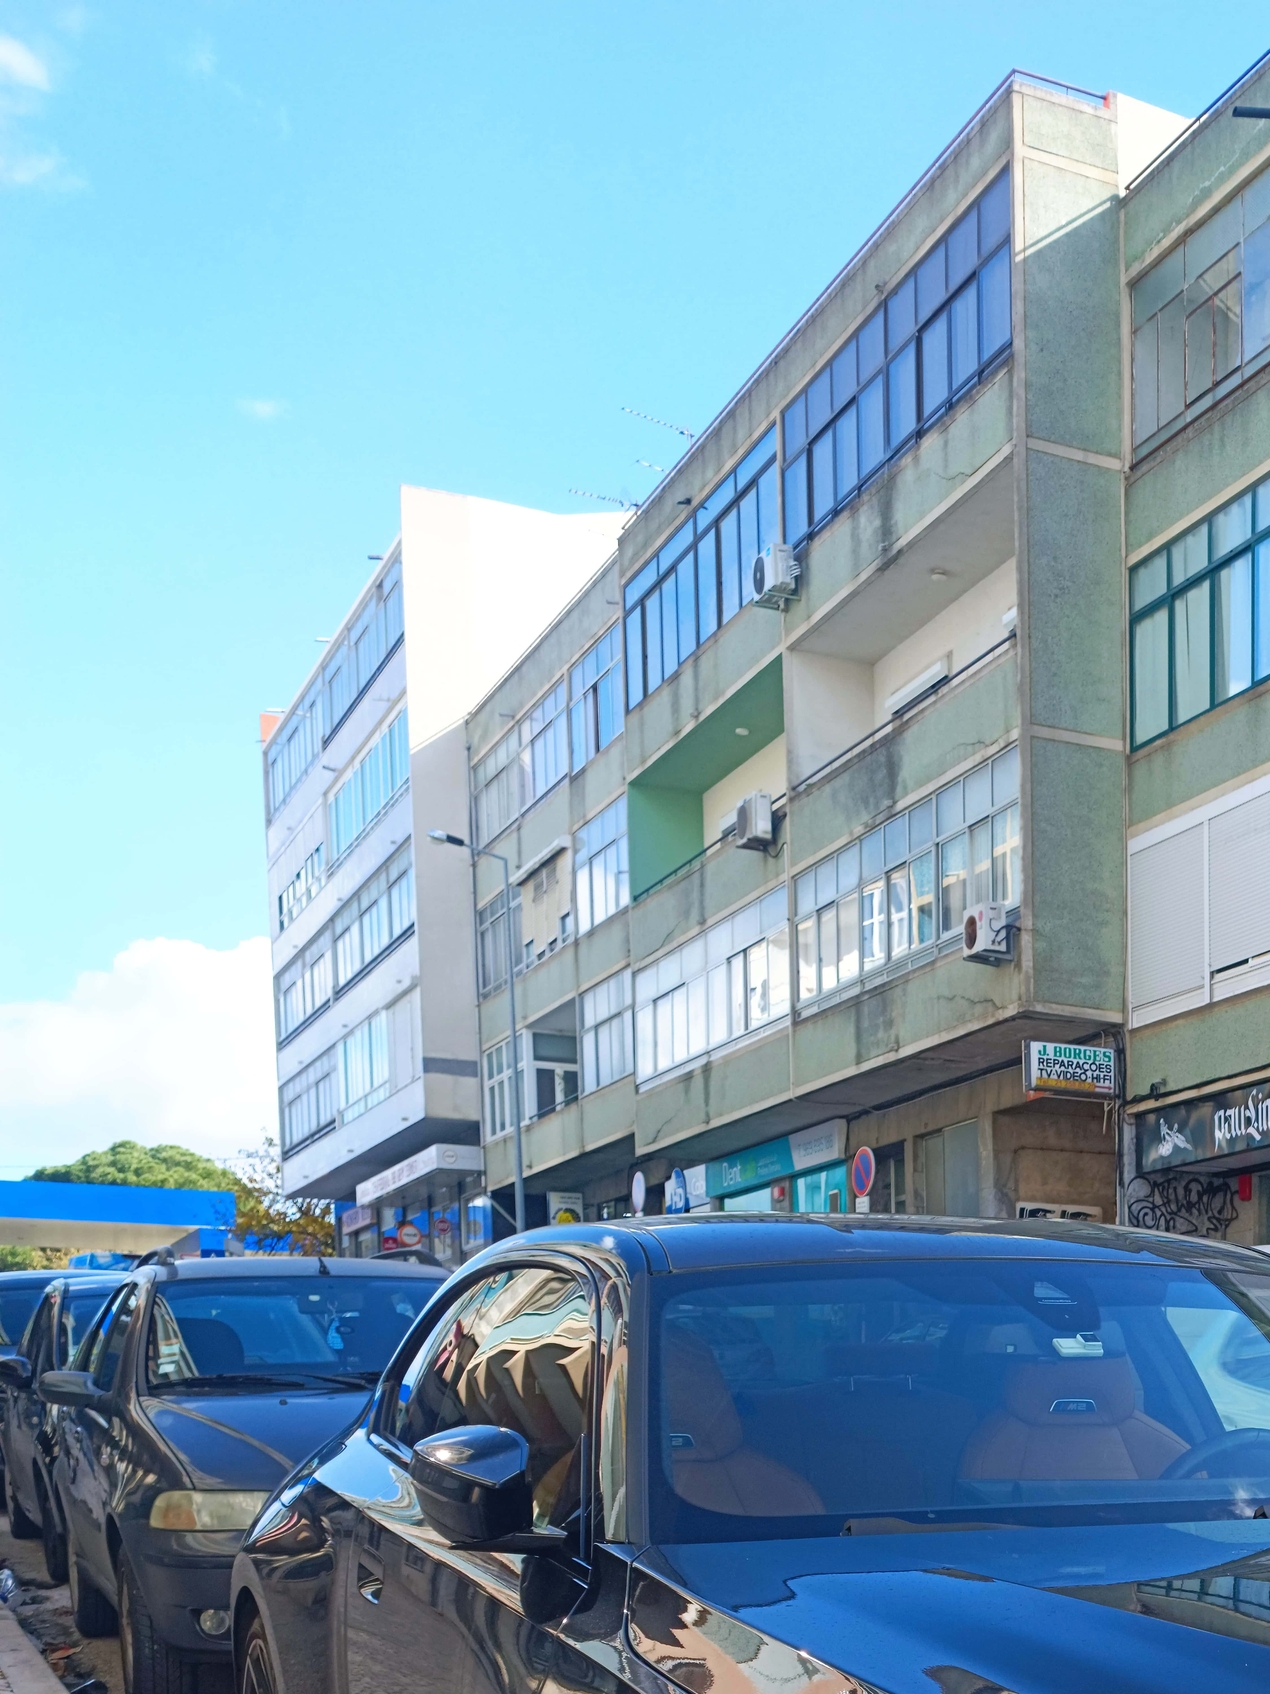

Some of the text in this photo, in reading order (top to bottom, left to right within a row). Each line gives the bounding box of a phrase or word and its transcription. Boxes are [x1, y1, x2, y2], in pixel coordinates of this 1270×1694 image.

[1037, 1044, 1112, 1063] J. BORGES
[1067, 1402, 1087, 1411] M2
